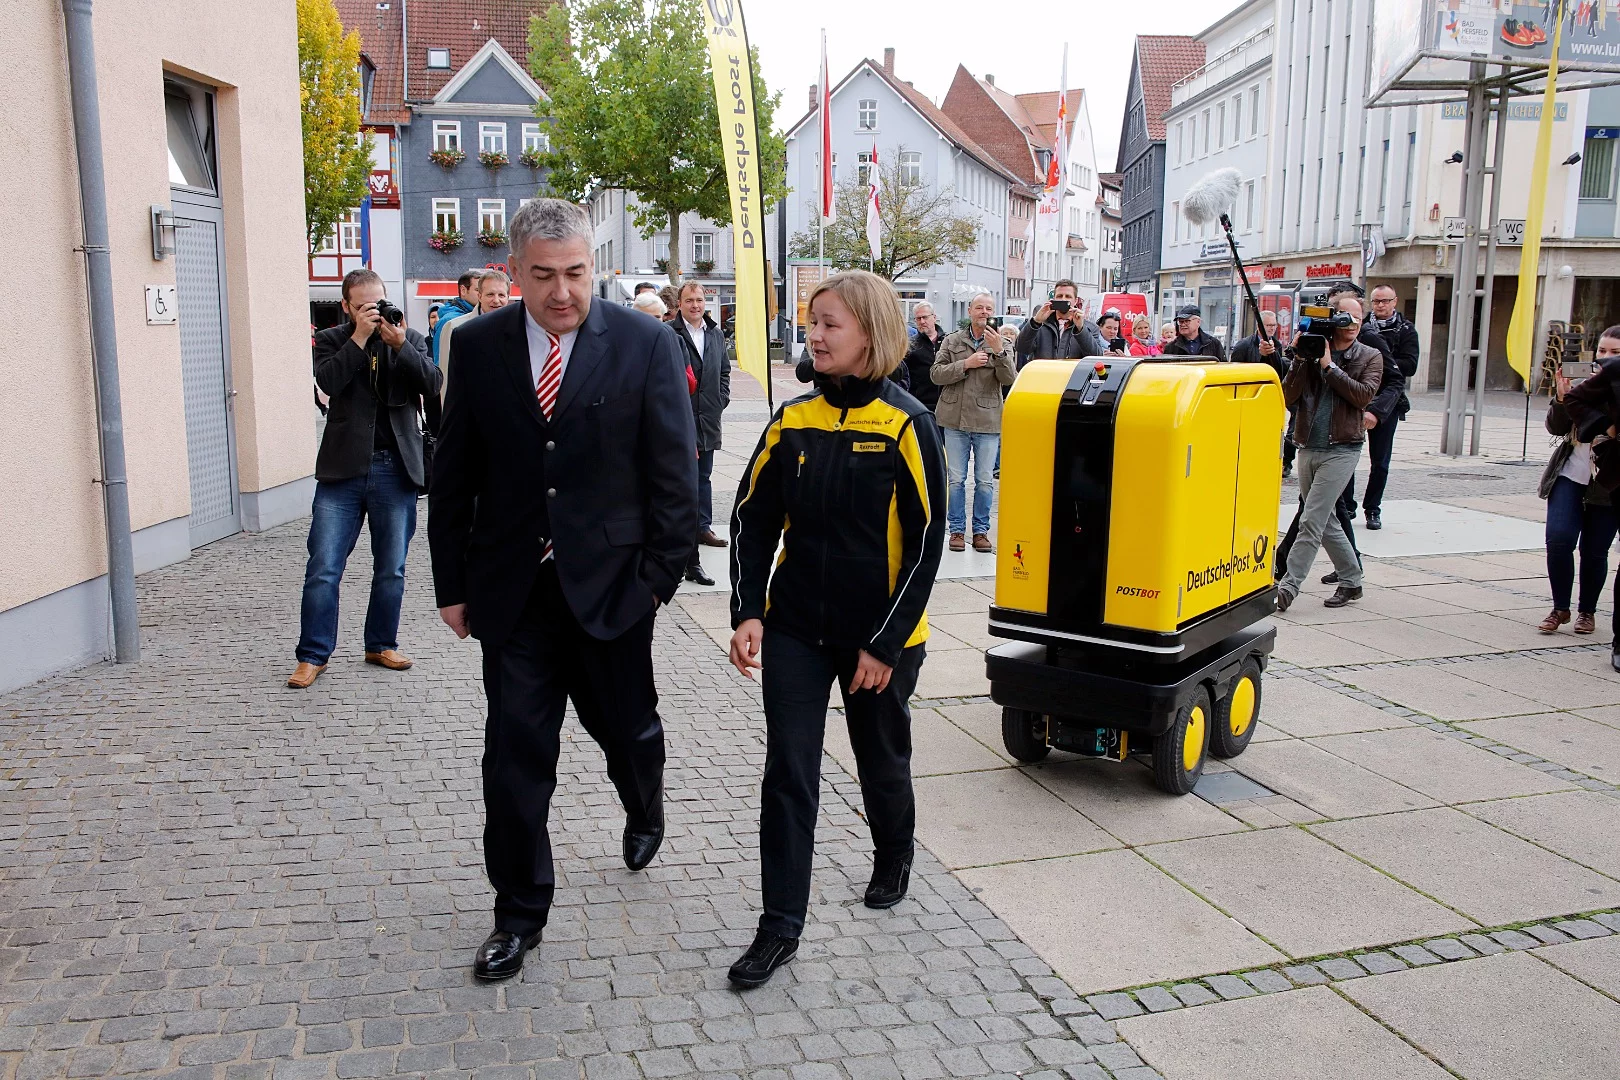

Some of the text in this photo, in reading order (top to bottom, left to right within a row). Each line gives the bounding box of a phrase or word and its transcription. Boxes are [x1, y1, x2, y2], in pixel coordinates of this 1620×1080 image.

[1461, 28, 1488, 36] HERSFELD
[1571, 42, 1620, 57] www.lul
[1455, 221, 1465, 229] WC
[1505, 223, 1523, 234] WC
[1187, 552, 1250, 592] Deutsche Post
[1116, 585, 1161, 599] POSTBOT
